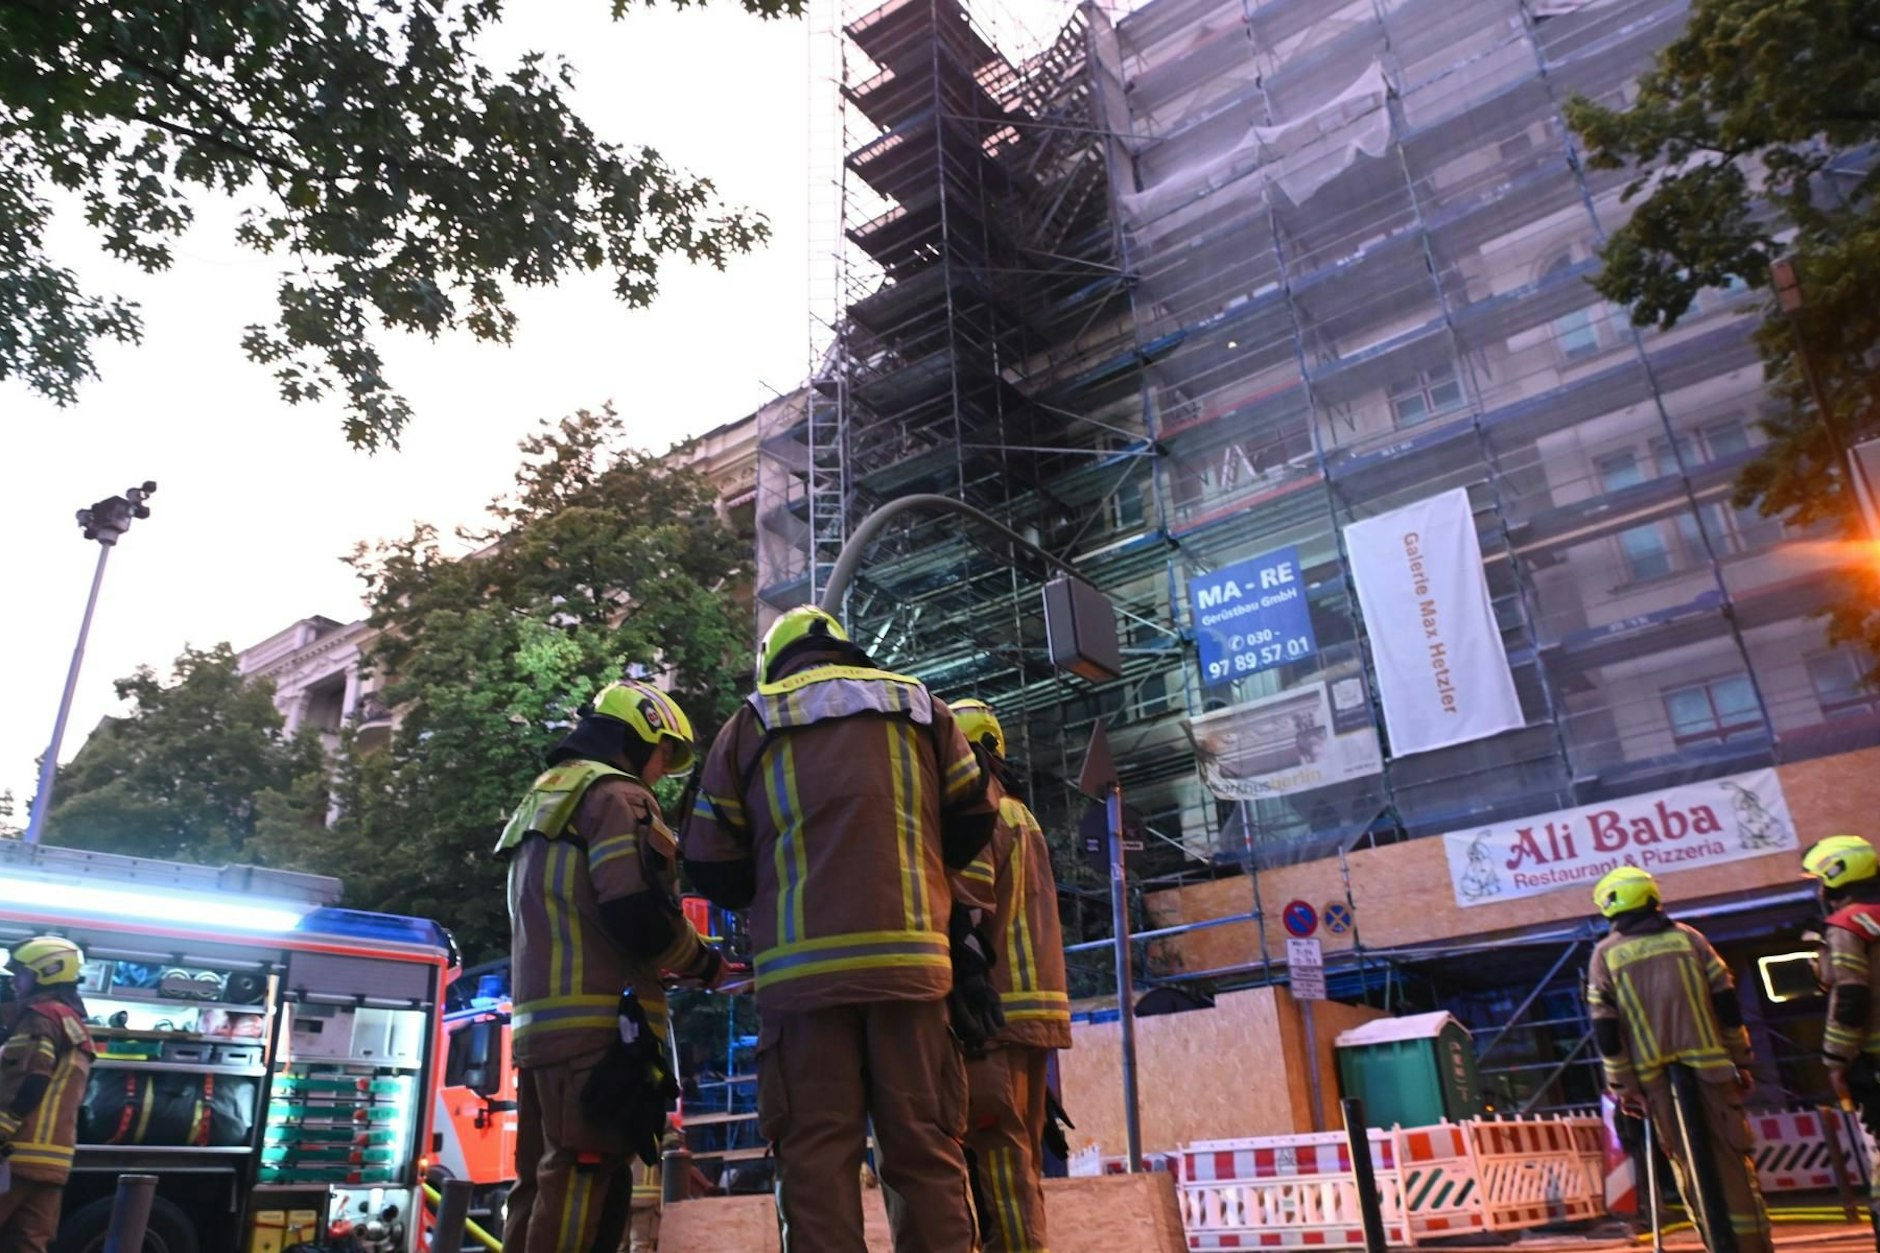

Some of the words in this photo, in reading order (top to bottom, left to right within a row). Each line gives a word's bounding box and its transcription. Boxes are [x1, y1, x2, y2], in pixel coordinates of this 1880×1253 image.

[1198, 580, 1242, 610] MA
[1260, 561, 1294, 590] RE
[1403, 532, 1429, 595] Galerie
[1202, 601, 1259, 626] Gerüstbau
[1261, 587, 1297, 607] GmbH
[1418, 599, 1439, 639] Max
[1208, 659, 1230, 679] 97
[1234, 651, 1257, 671] 89
[1260, 643, 1281, 664] 57
[1287, 636, 1309, 656] 01
[1246, 629, 1273, 646] 030
[1428, 642, 1458, 714] Hetzler
[1506, 822, 1579, 870] Ali
[1585, 800, 1723, 852] Baba
[1513, 859, 1617, 889] Restaurant
[1624, 854, 1639, 868] &
[1641, 839, 1726, 867] Pizzeria
